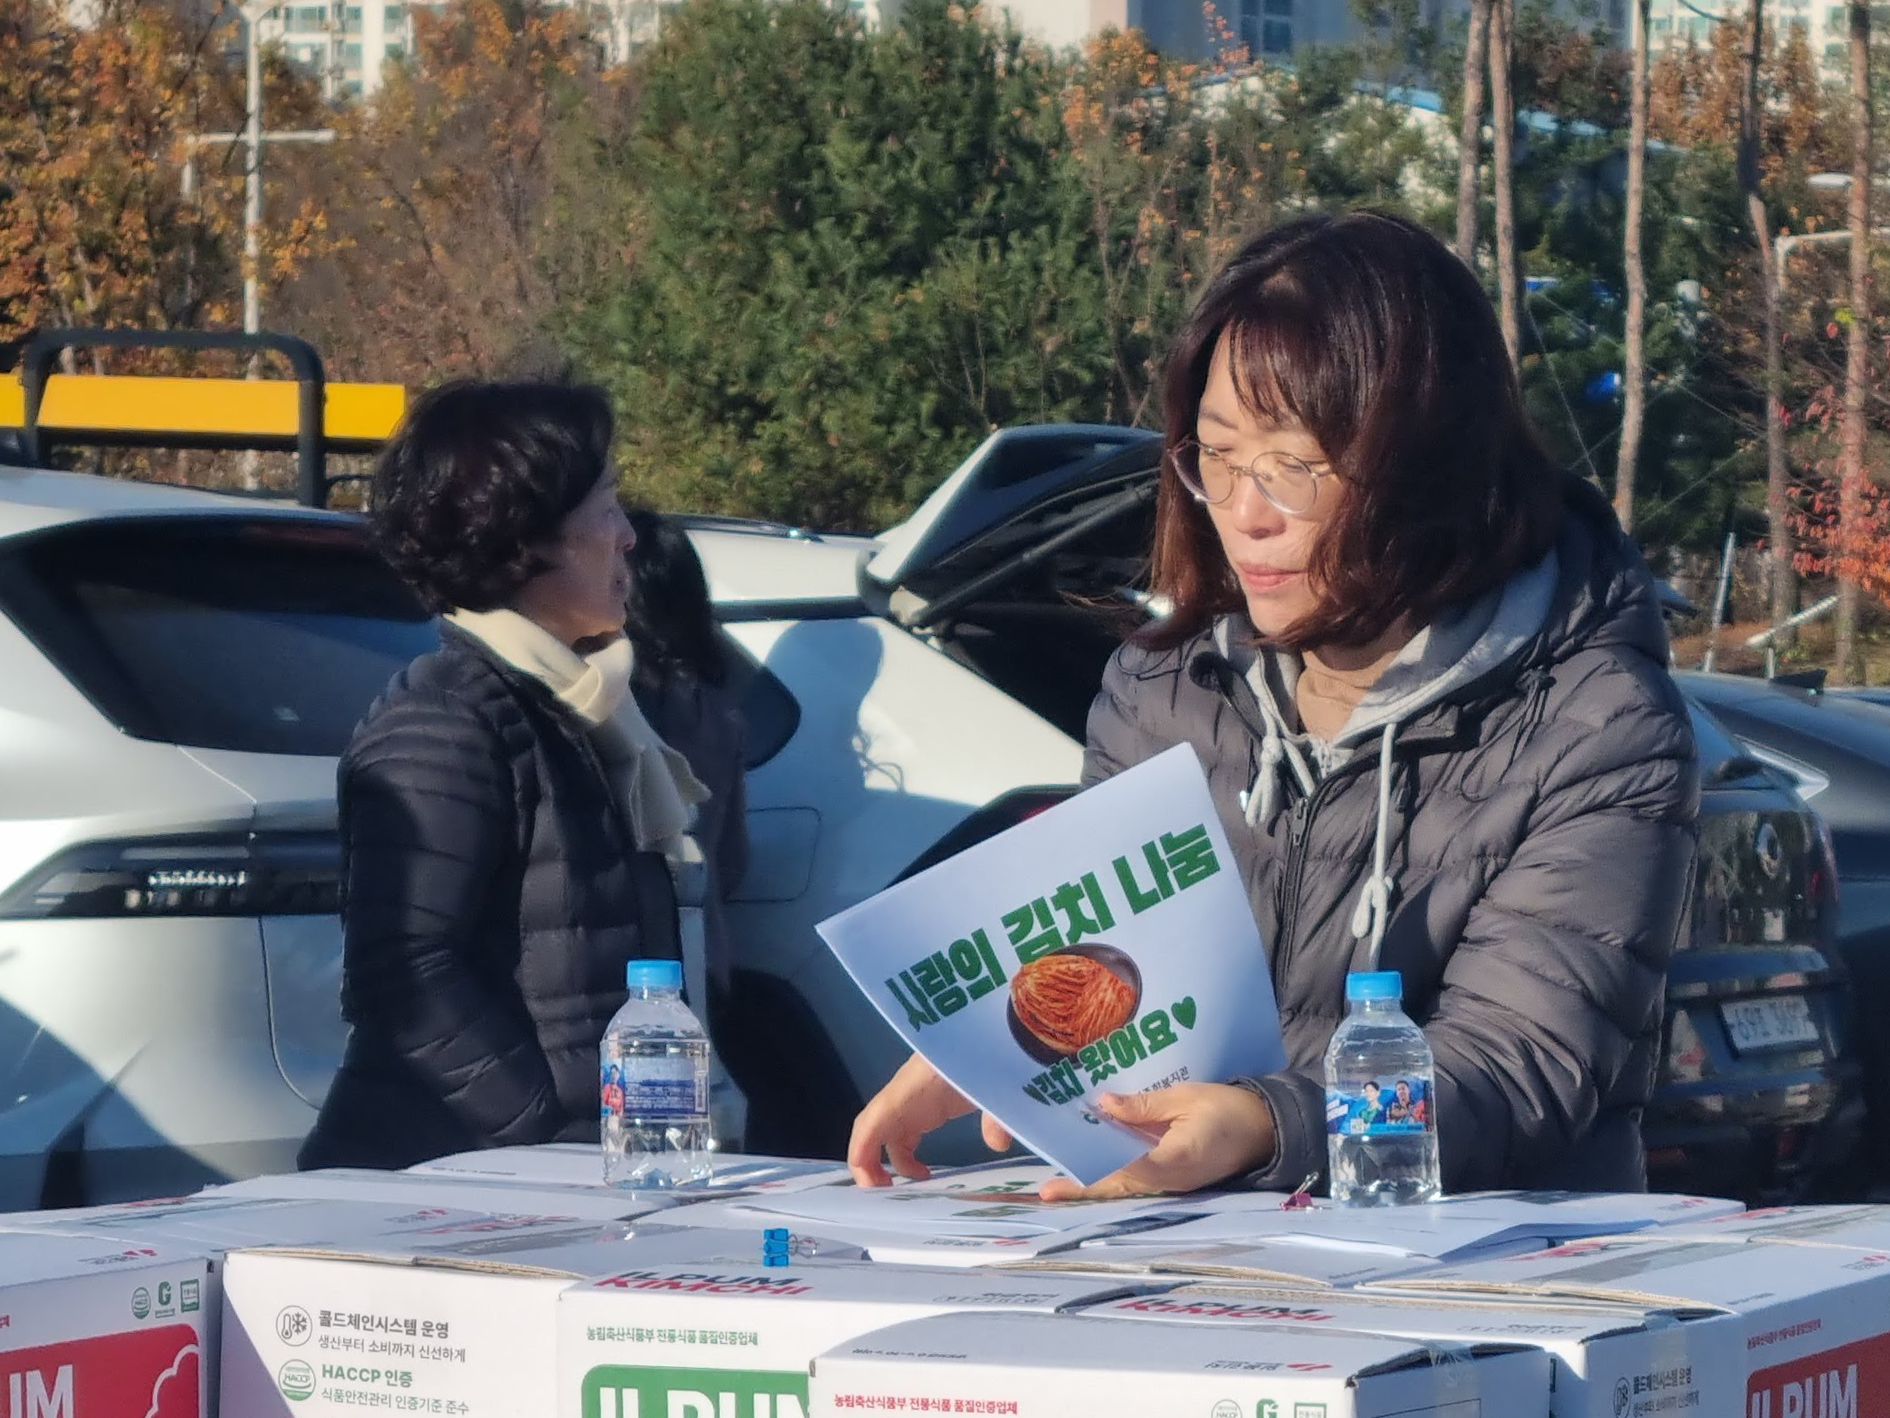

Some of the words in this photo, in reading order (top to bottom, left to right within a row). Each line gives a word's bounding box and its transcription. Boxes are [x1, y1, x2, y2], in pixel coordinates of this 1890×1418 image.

[884, 927, 1007, 1032] 사랑의
[1000, 871, 1116, 966] 김치
[1111, 823, 1221, 915] 나눔
[1079, 1008, 1178, 1087] 왔어요
[594, 1278, 813, 1295] KIMCHI
[318, 1309, 417, 1336] 콜드체인시스템
[420, 1320, 448, 1339] 운영
[321, 1363, 381, 1383] HACCP
[384, 1369, 412, 1388] 인증
[909, 1397, 951, 1412] 전통식품
[953, 1399, 1018, 1415] 품질인증업체
